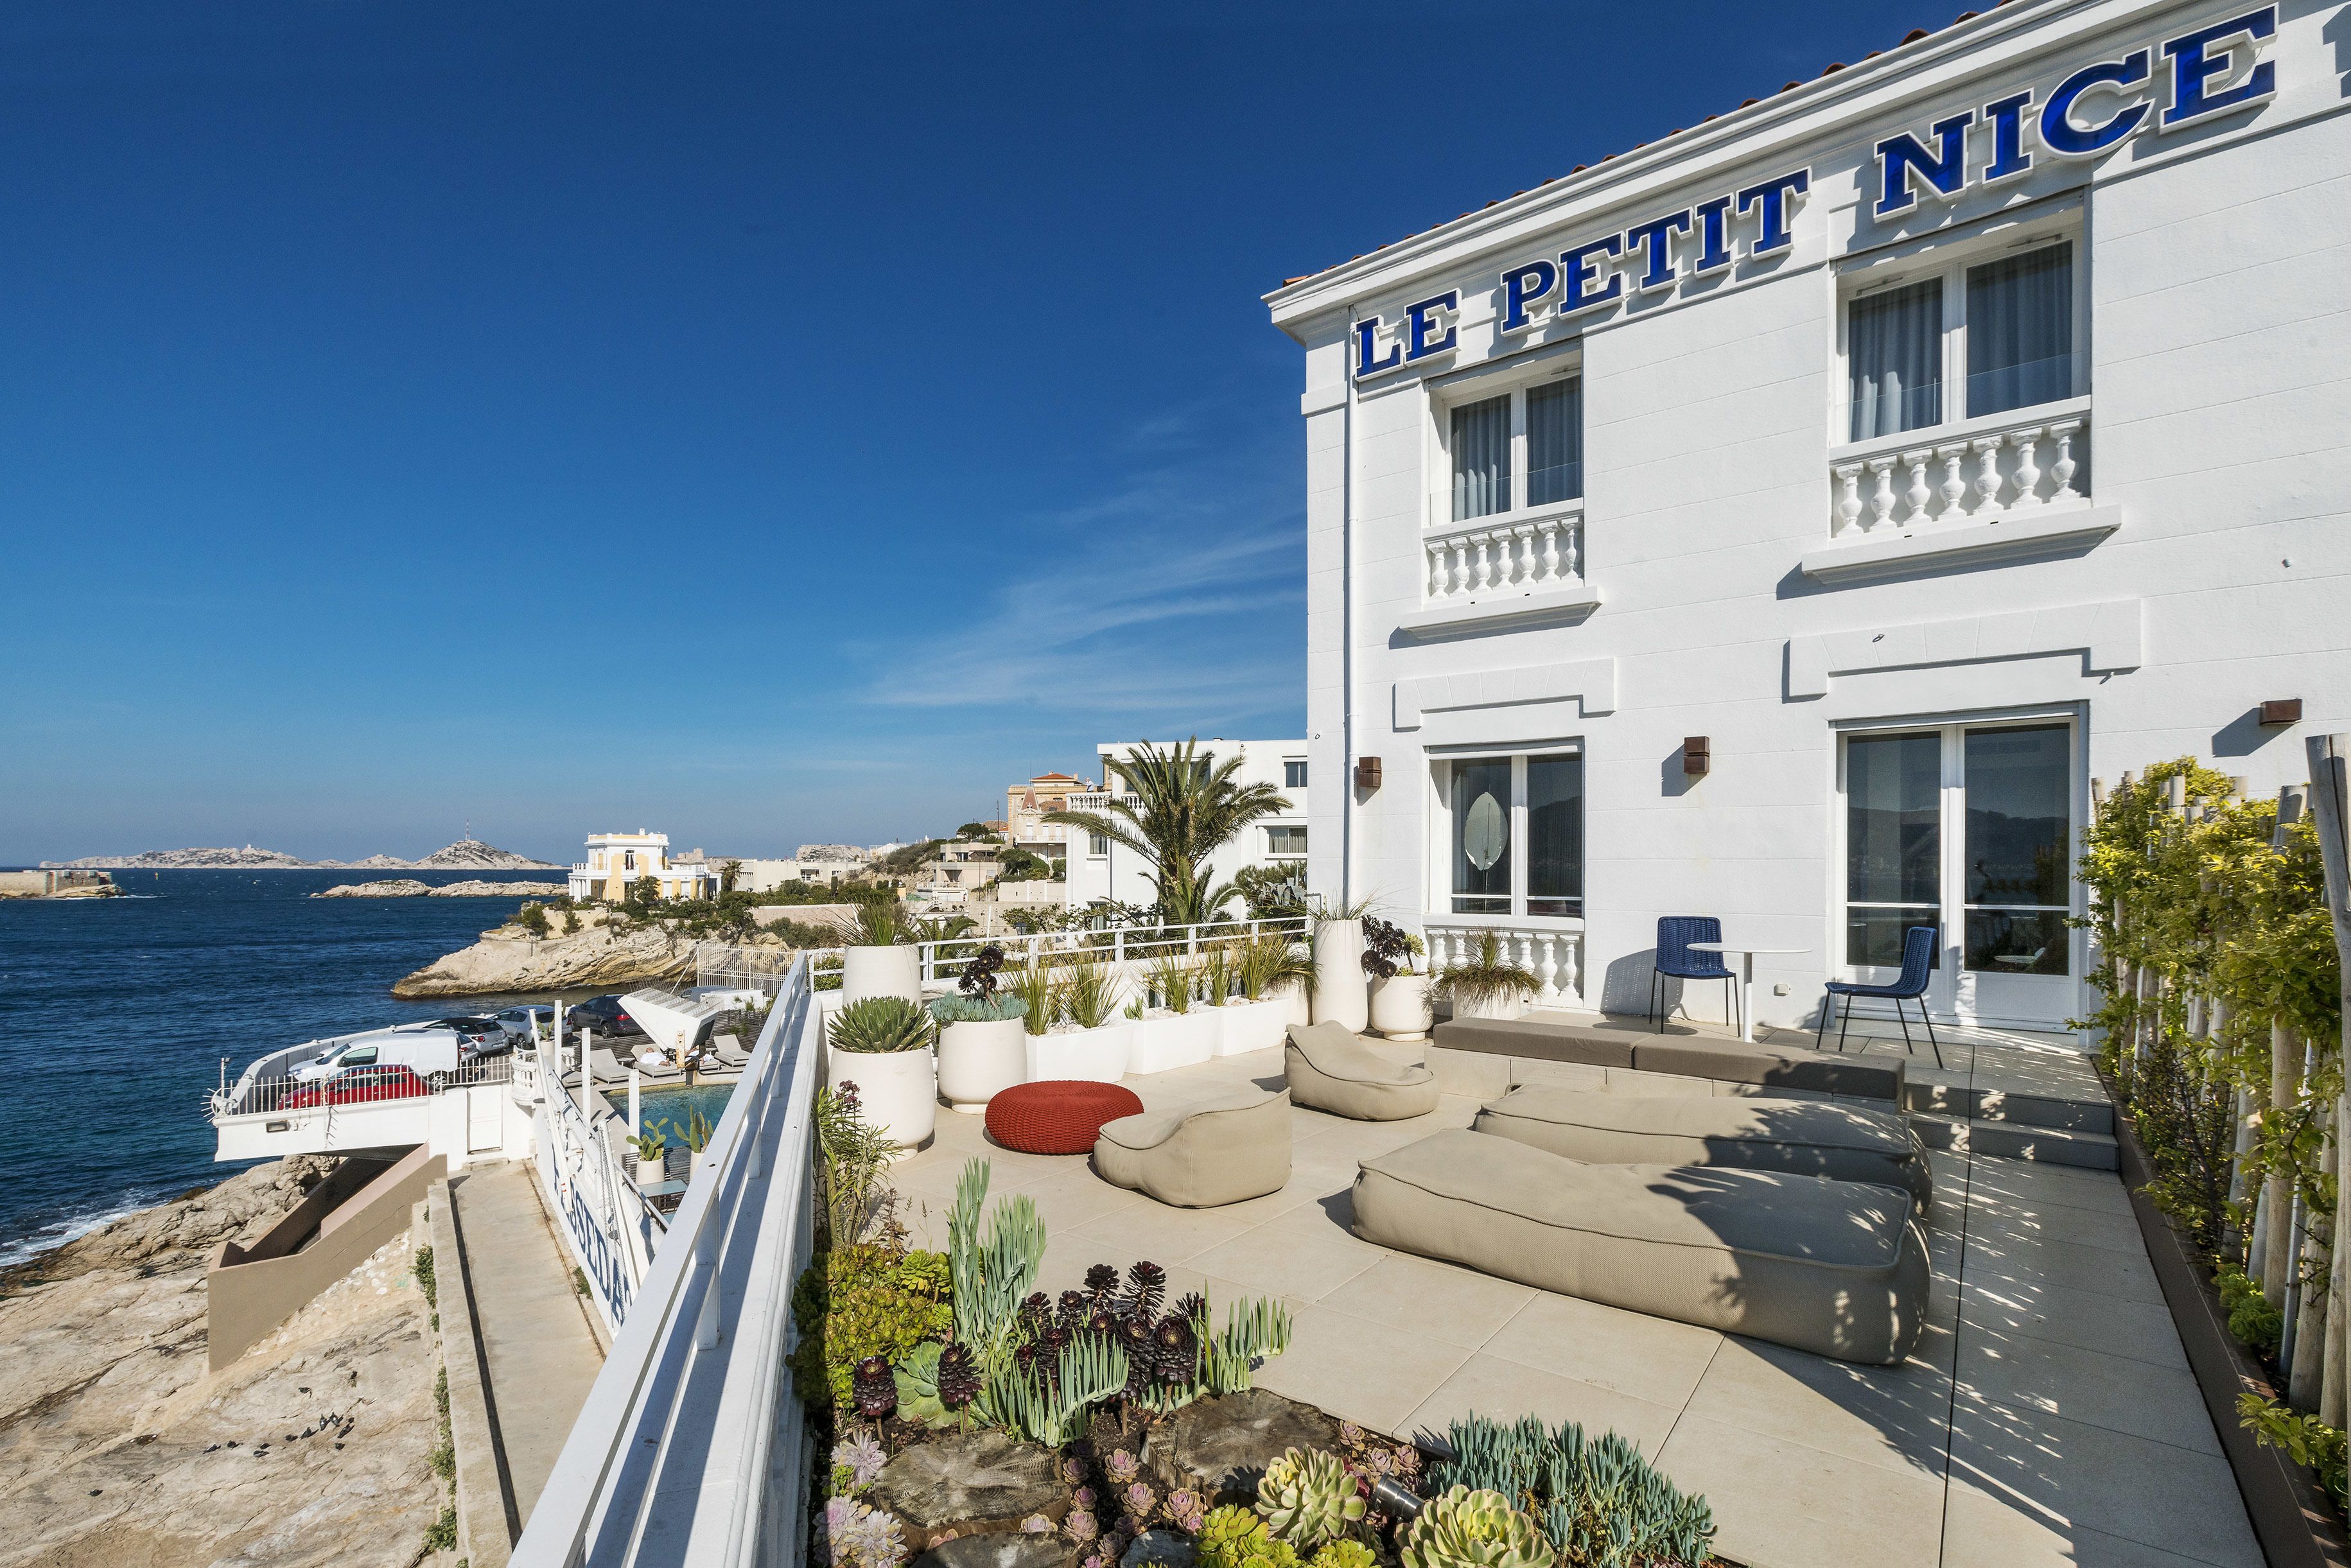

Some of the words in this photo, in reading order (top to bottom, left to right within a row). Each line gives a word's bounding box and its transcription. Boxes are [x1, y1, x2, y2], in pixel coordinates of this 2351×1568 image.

[1355, 288, 1460, 380] LE
[1501, 166, 1812, 336] PETIT
[1874, 2, 2279, 221] NICE
